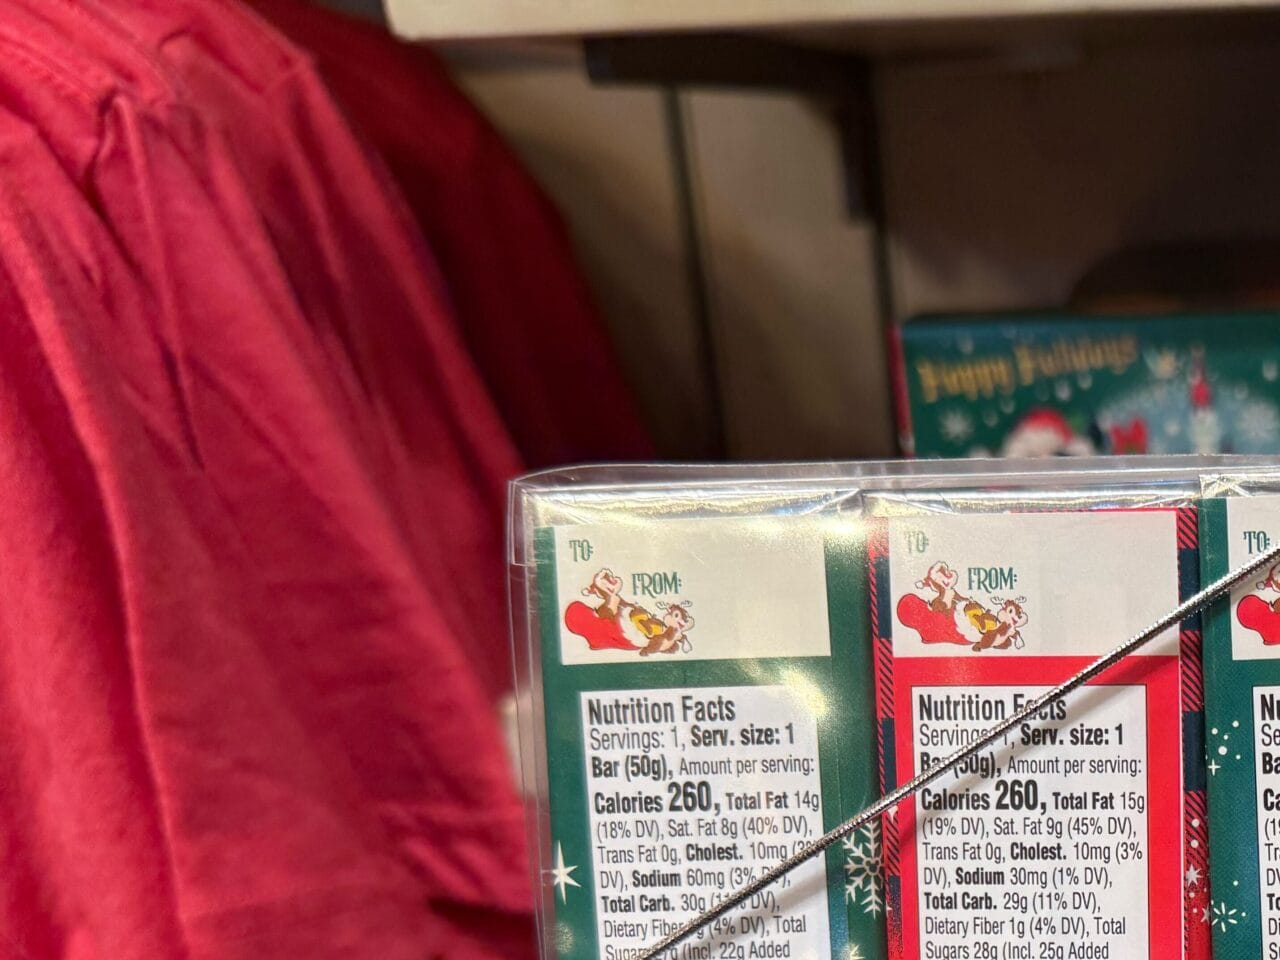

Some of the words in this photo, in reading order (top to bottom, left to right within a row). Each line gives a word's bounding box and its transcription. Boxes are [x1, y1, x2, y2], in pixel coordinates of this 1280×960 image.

[569, 539, 593, 562] TO:
[1243, 531, 1270, 554] TO:
[632, 572, 682, 598] FROM:
[967, 567, 1018, 593] FROM:
[588, 697, 675, 725] Nutrition
[682, 695, 735, 722] Facts
[919, 694, 1005, 721] Nutrition
[590, 727, 665, 753] Servings:
[671, 726, 685, 750] 1,
[691, 724, 735, 746] Serv.
[741, 723, 780, 745] size:
[785, 722, 794, 744] 1
[592, 757, 620, 778] Bar
[625, 755, 674, 781] (50g),
[679, 757, 732, 776] Amount
[737, 759, 757, 778] per
[761, 755, 815, 776] serving:
[595, 792, 663, 813] Calories
[668, 781, 721, 815] 260,
[725, 793, 763, 811] Total
[766, 791, 789, 810] Fat
[794, 790, 820, 811] 14g
[921, 789, 990, 810] Calories
[995, 779, 1047, 815] 260,
[1052, 792, 1090, 810] Total
[1092, 792, 1114, 810] Fat
[1121, 793, 1145, 812] 15g
